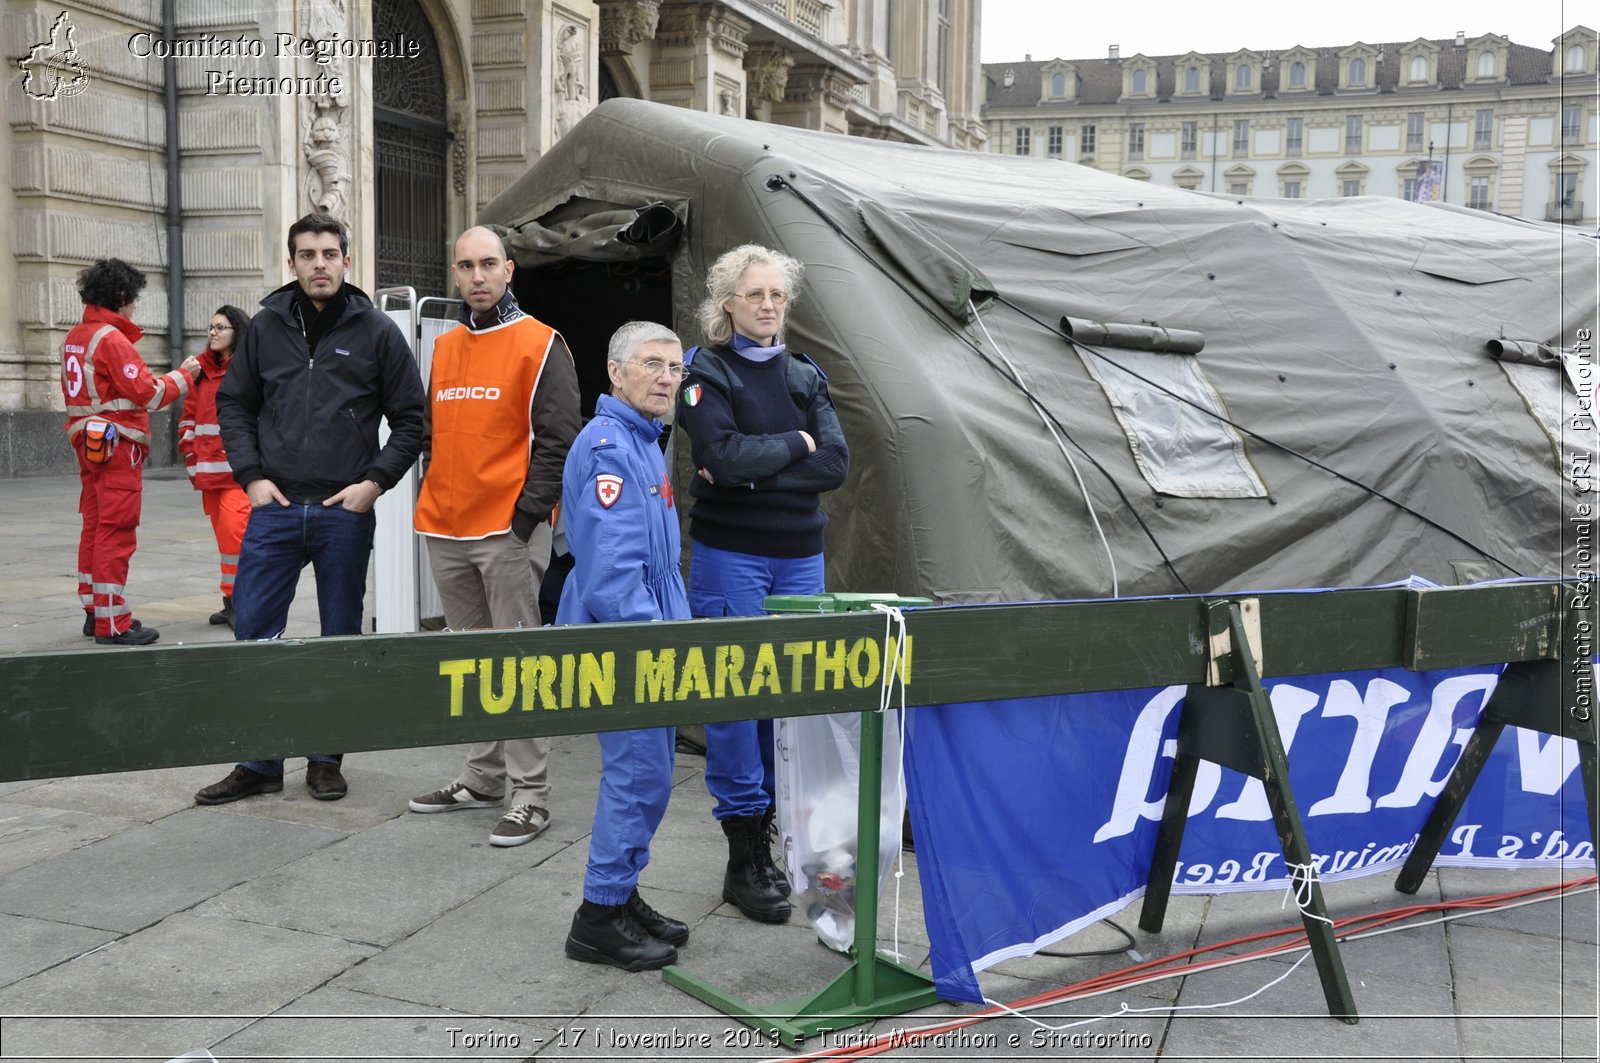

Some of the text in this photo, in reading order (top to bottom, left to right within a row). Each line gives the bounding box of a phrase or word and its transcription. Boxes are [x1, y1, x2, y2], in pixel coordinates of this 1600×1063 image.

[435, 386, 501, 402] MEDICO
[439, 635, 914, 717] TURIN MARATHON
